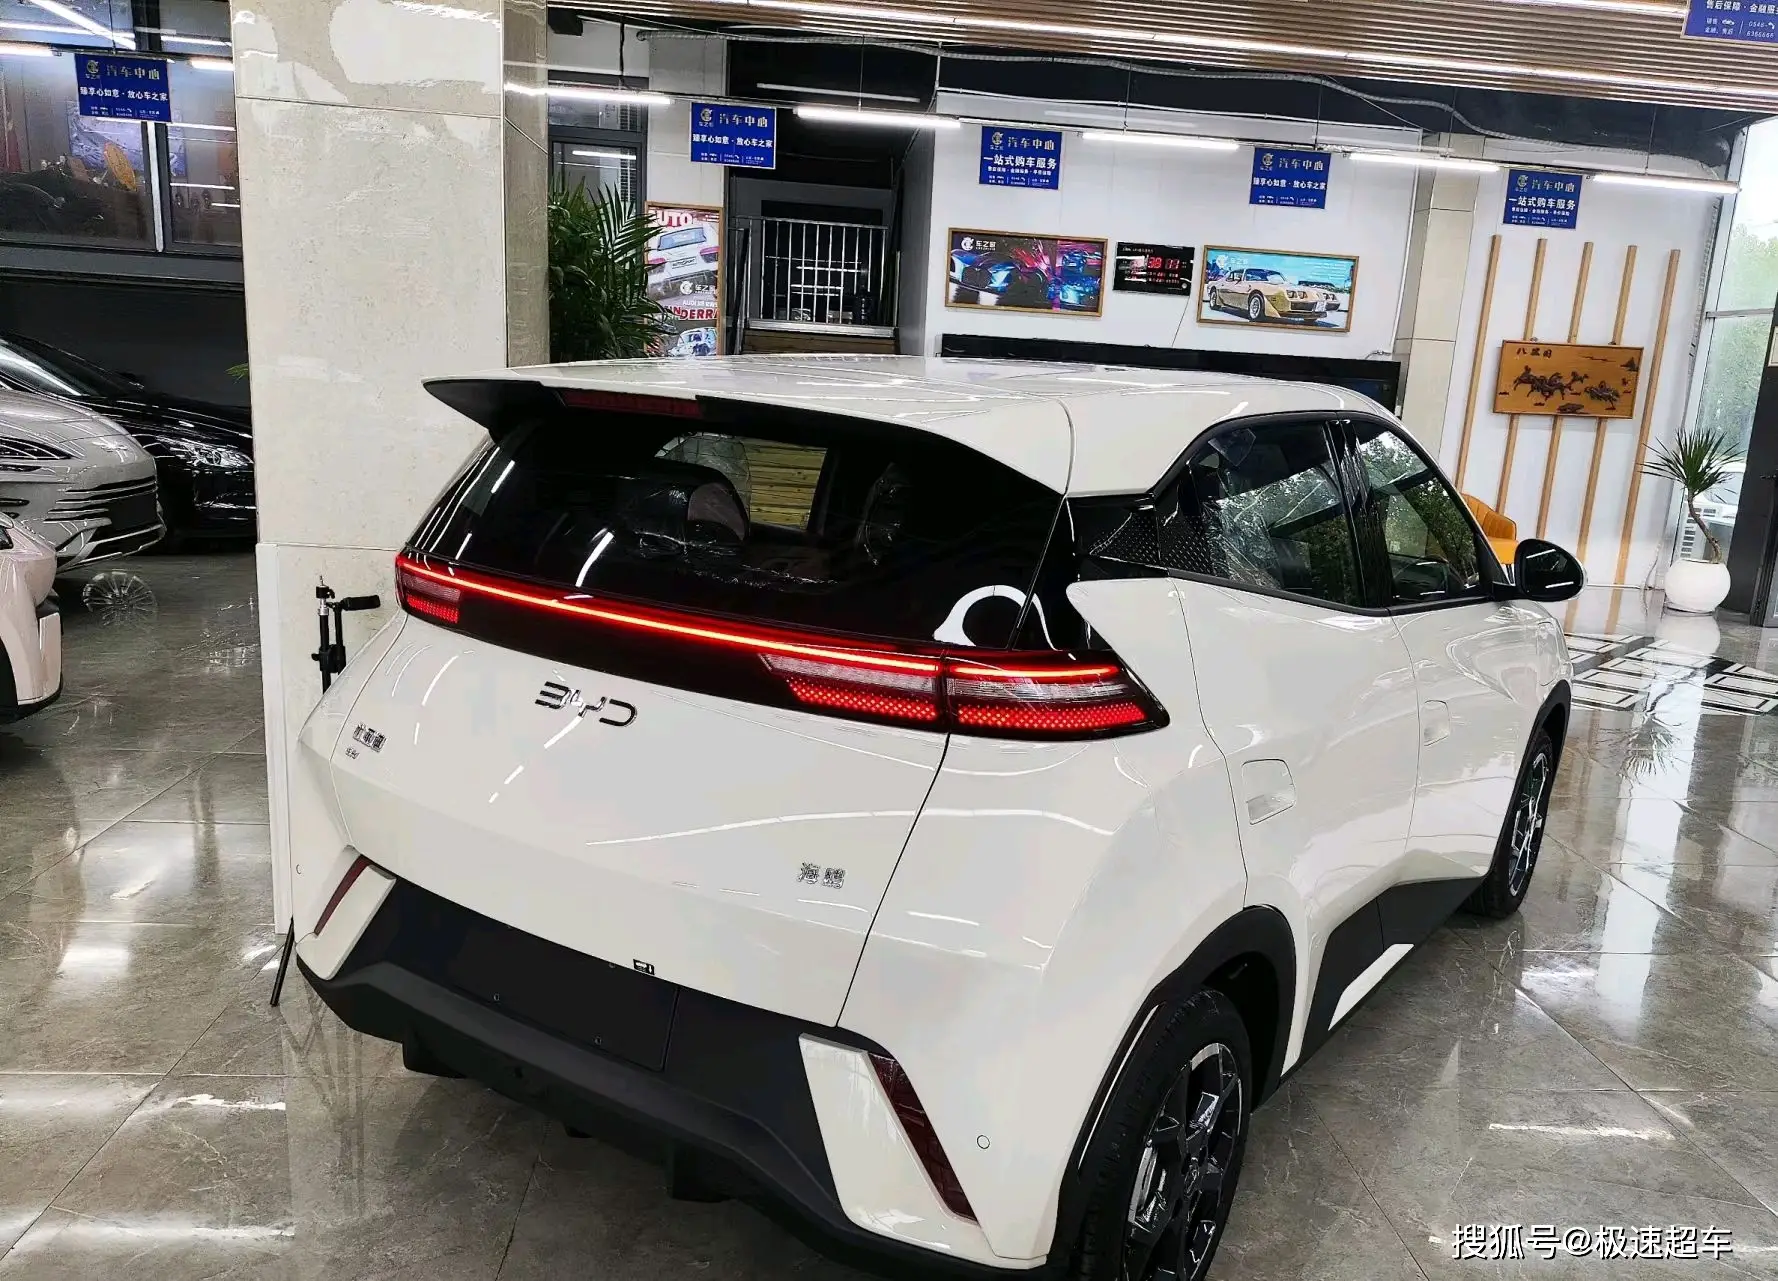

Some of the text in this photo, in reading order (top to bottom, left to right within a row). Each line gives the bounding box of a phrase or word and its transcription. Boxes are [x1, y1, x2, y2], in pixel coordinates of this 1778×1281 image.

[983, 153, 1057, 170] 一站式购车服务
[1508, 196, 1576, 211] 一站式购车服务
[535, 681, 638, 727] BYD
